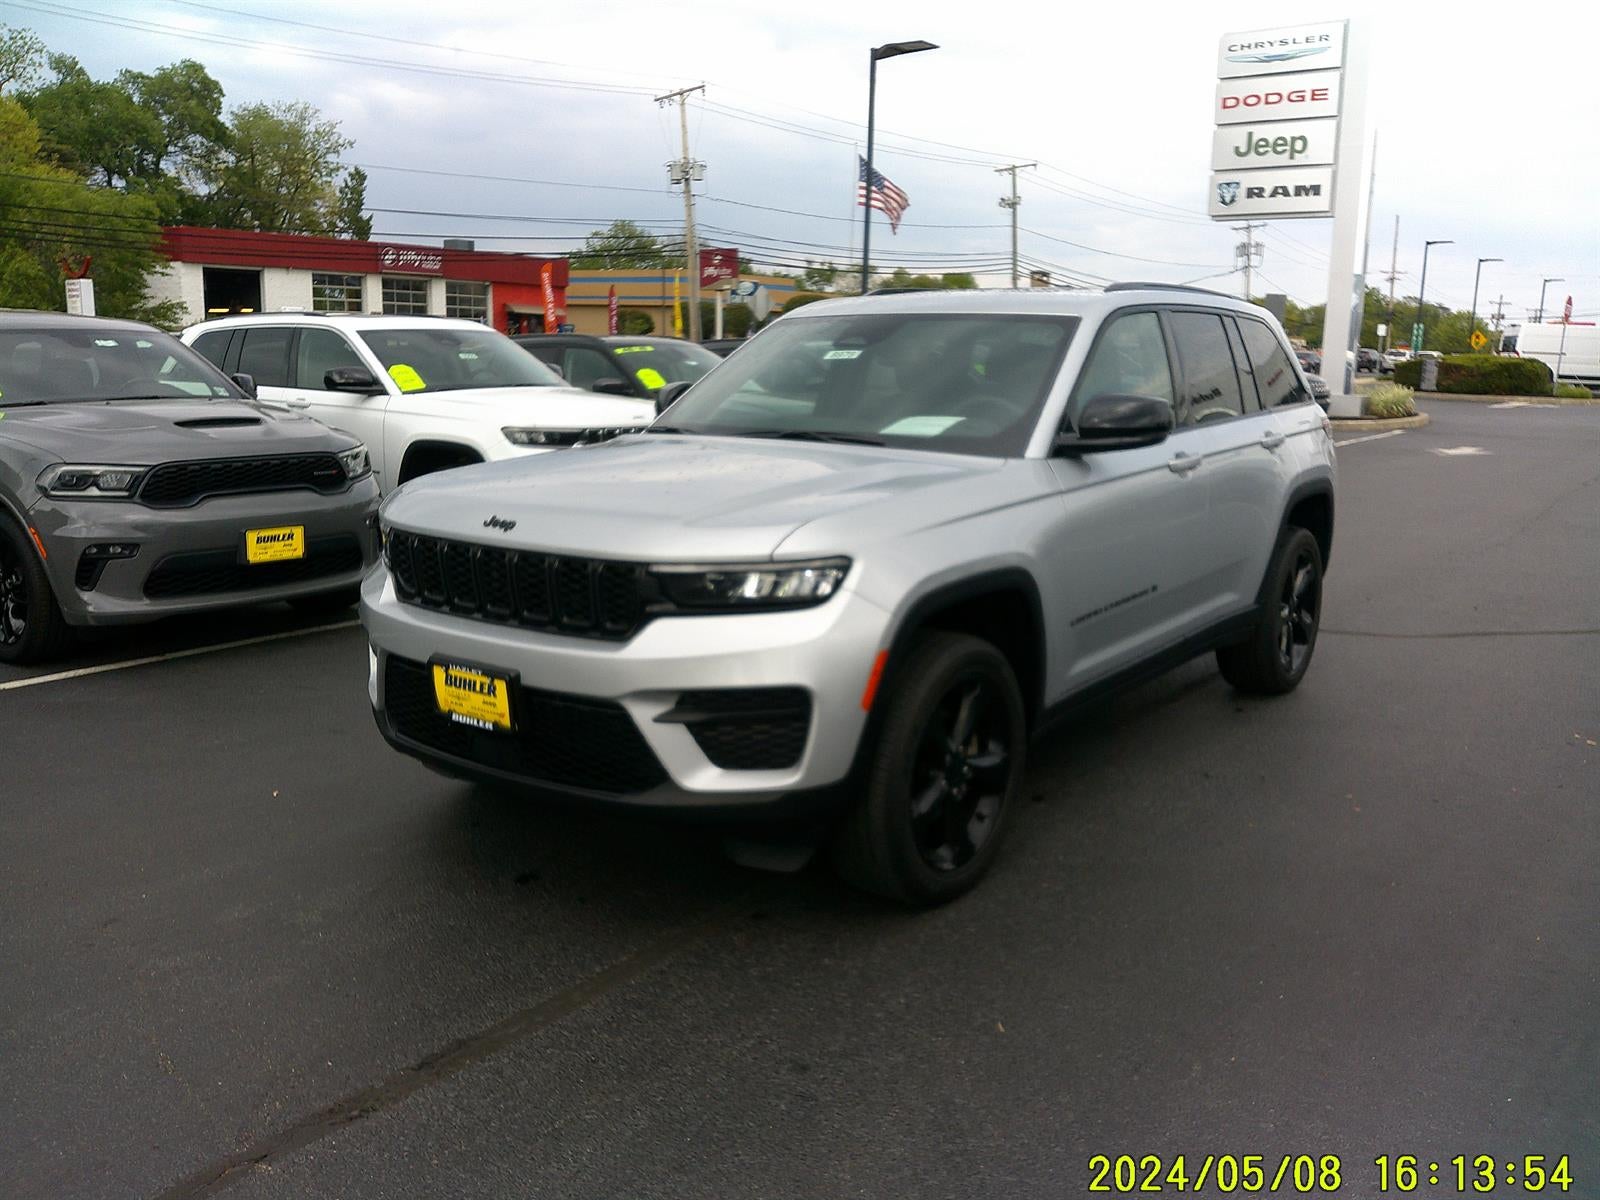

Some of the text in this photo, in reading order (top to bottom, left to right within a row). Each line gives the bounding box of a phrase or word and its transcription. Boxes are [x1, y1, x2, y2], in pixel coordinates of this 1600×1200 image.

[1227, 34, 1330, 52] CHRYSLER
[1221, 87, 1329, 110] DODGE
[1234, 131, 1308, 160] Jeep
[1246, 184, 1321, 200] RAM
[483, 515, 517, 533] Jeep
[256, 533, 294, 544] BUHLER
[445, 674, 497, 698] BUHLER
